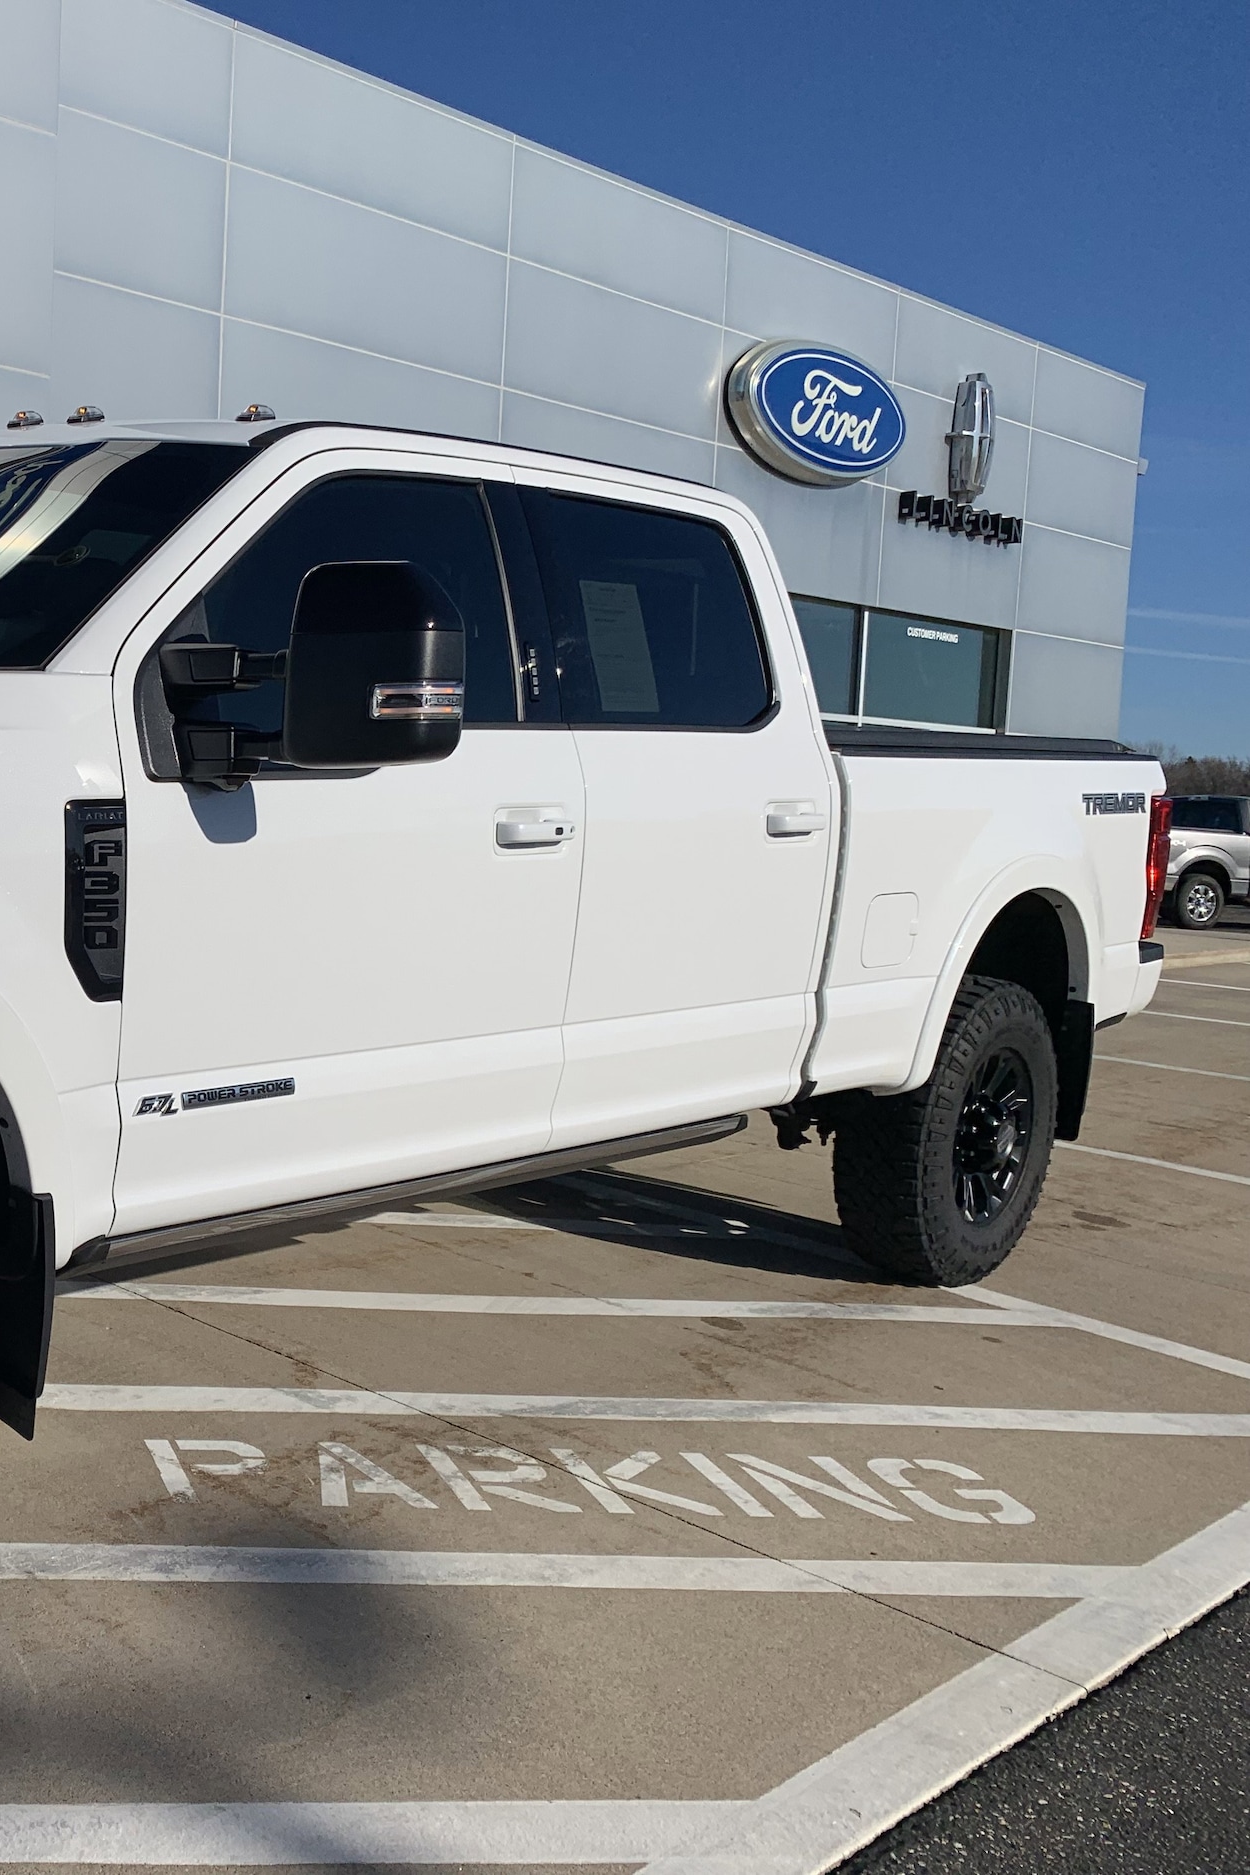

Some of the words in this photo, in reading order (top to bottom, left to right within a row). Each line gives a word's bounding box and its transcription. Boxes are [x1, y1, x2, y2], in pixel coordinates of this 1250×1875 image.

[791, 369, 881, 454] Ford
[906, 626, 936, 640] CUSTOMER
[936, 631, 959, 644] PARKING
[1082, 792, 1147, 816] TREMOR
[187, 1088, 236, 1105] POWER
[239, 1080, 293, 1097] STROKE
[144, 1438, 1037, 1526] PARKING
